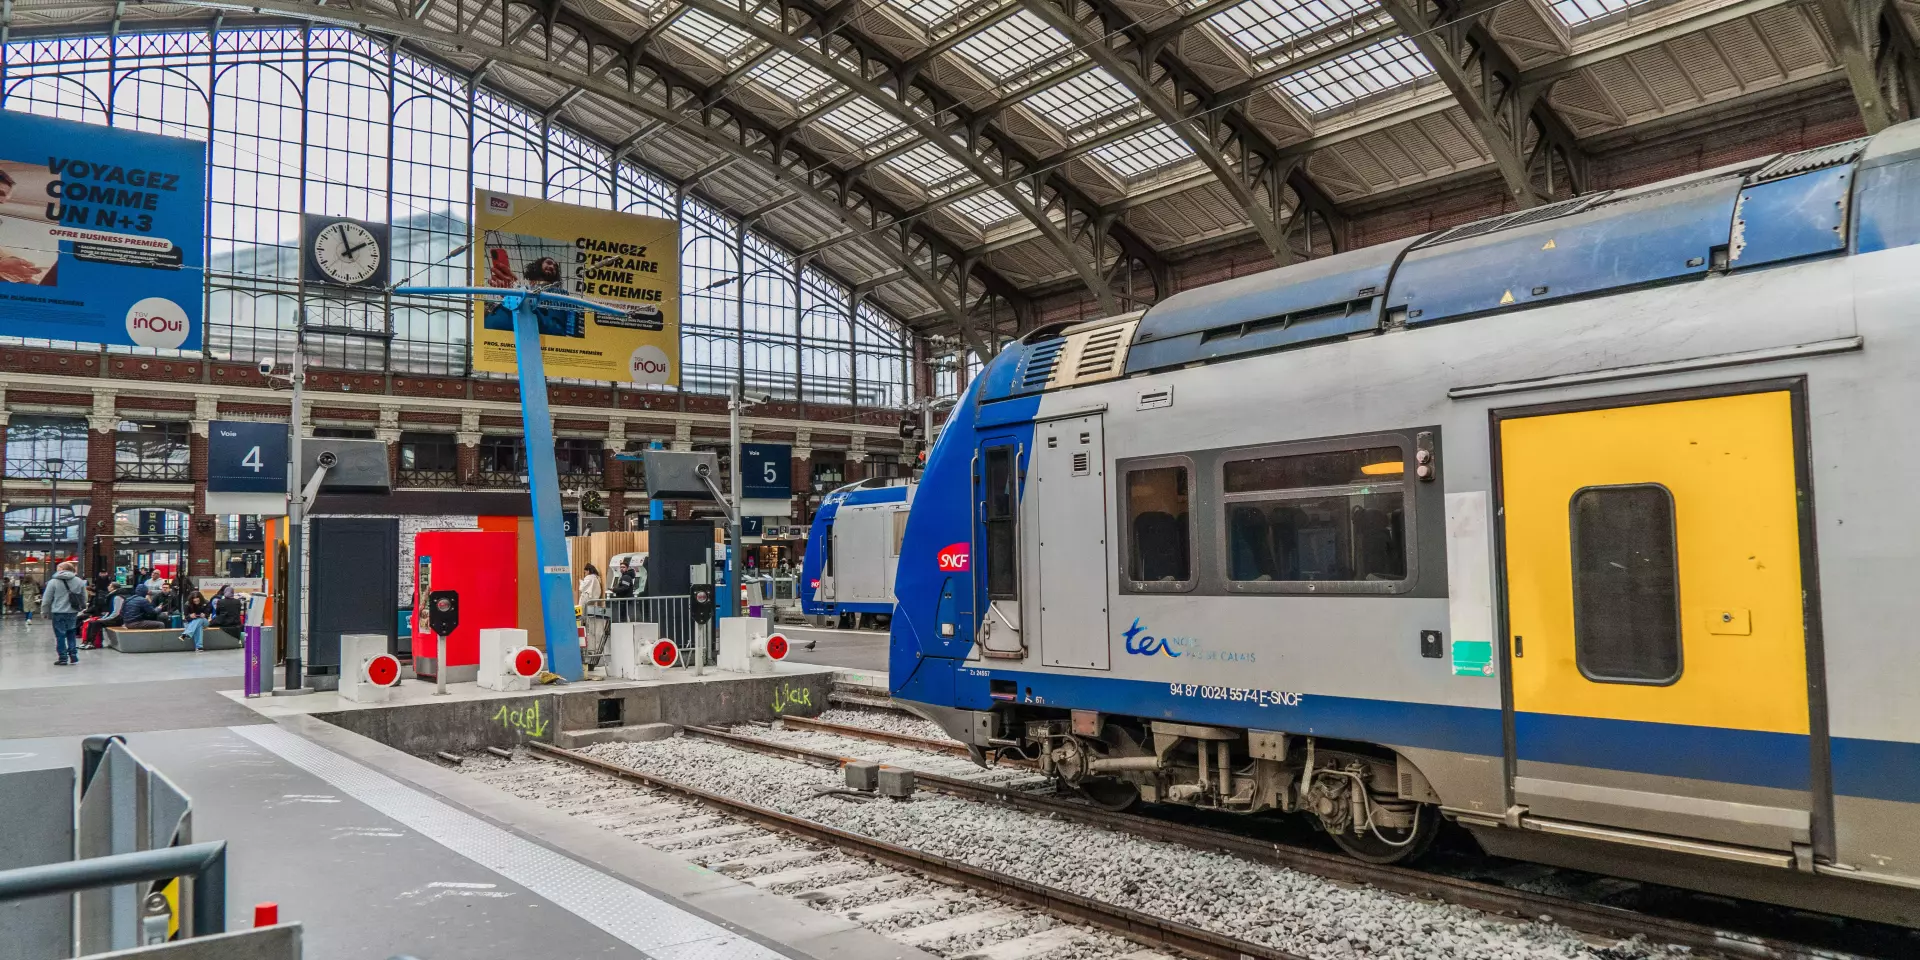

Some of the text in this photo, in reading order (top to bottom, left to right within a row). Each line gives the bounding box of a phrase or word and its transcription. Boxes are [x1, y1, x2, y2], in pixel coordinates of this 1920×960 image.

[48, 156, 180, 191] VOYAGEZ
[46, 180, 159, 211] COMME
[45, 202, 153, 232] UN N+3
[49, 229, 168, 248] OFFRE BUSINESS PREMIÈRE
[575, 237, 647, 258] CHANGEZ
[575, 266, 634, 284] COMME
[575, 280, 596, 294] DE
[598, 284, 662, 302] CHEMISE
[241, 445, 264, 473] 4
[763, 461, 777, 483] 5
[563, 520, 570, 531] 6
[750, 520, 757, 530] 7
[940, 553, 969, 568] SNCF
[1220, 650, 1256, 663] CALAIS
[1170, 683, 1303, 707] 94 87 0024 557-4 F-SNCF
